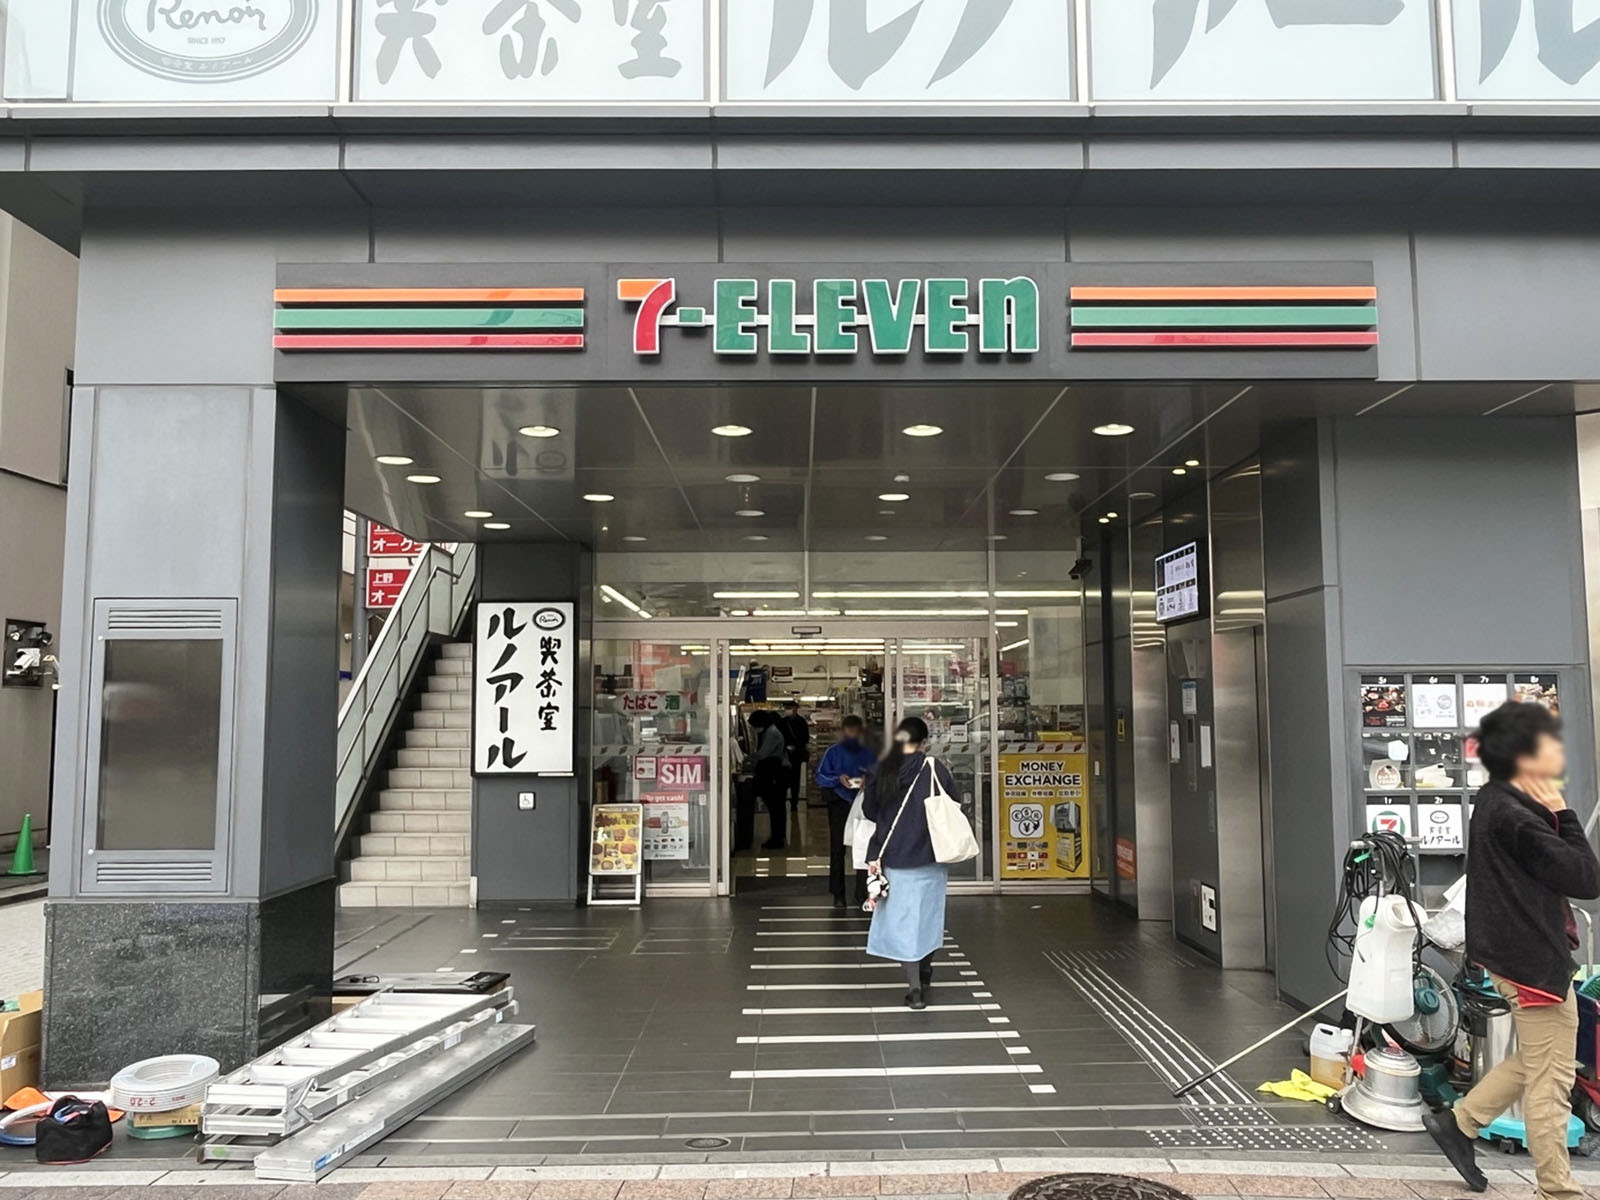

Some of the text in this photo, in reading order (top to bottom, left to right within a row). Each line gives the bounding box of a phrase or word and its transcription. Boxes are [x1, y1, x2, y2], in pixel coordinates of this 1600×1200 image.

[373, 573, 394, 584] 上野
[486, 607, 528, 769] ルノアール
[535, 636, 562, 731] 喫茶室
[623, 694, 681, 710] たばこ 酒
[661, 764, 702, 784] SIM
[1021, 762, 1064, 771] MONEY
[1005, 775, 1081, 785] EXCHANGE
